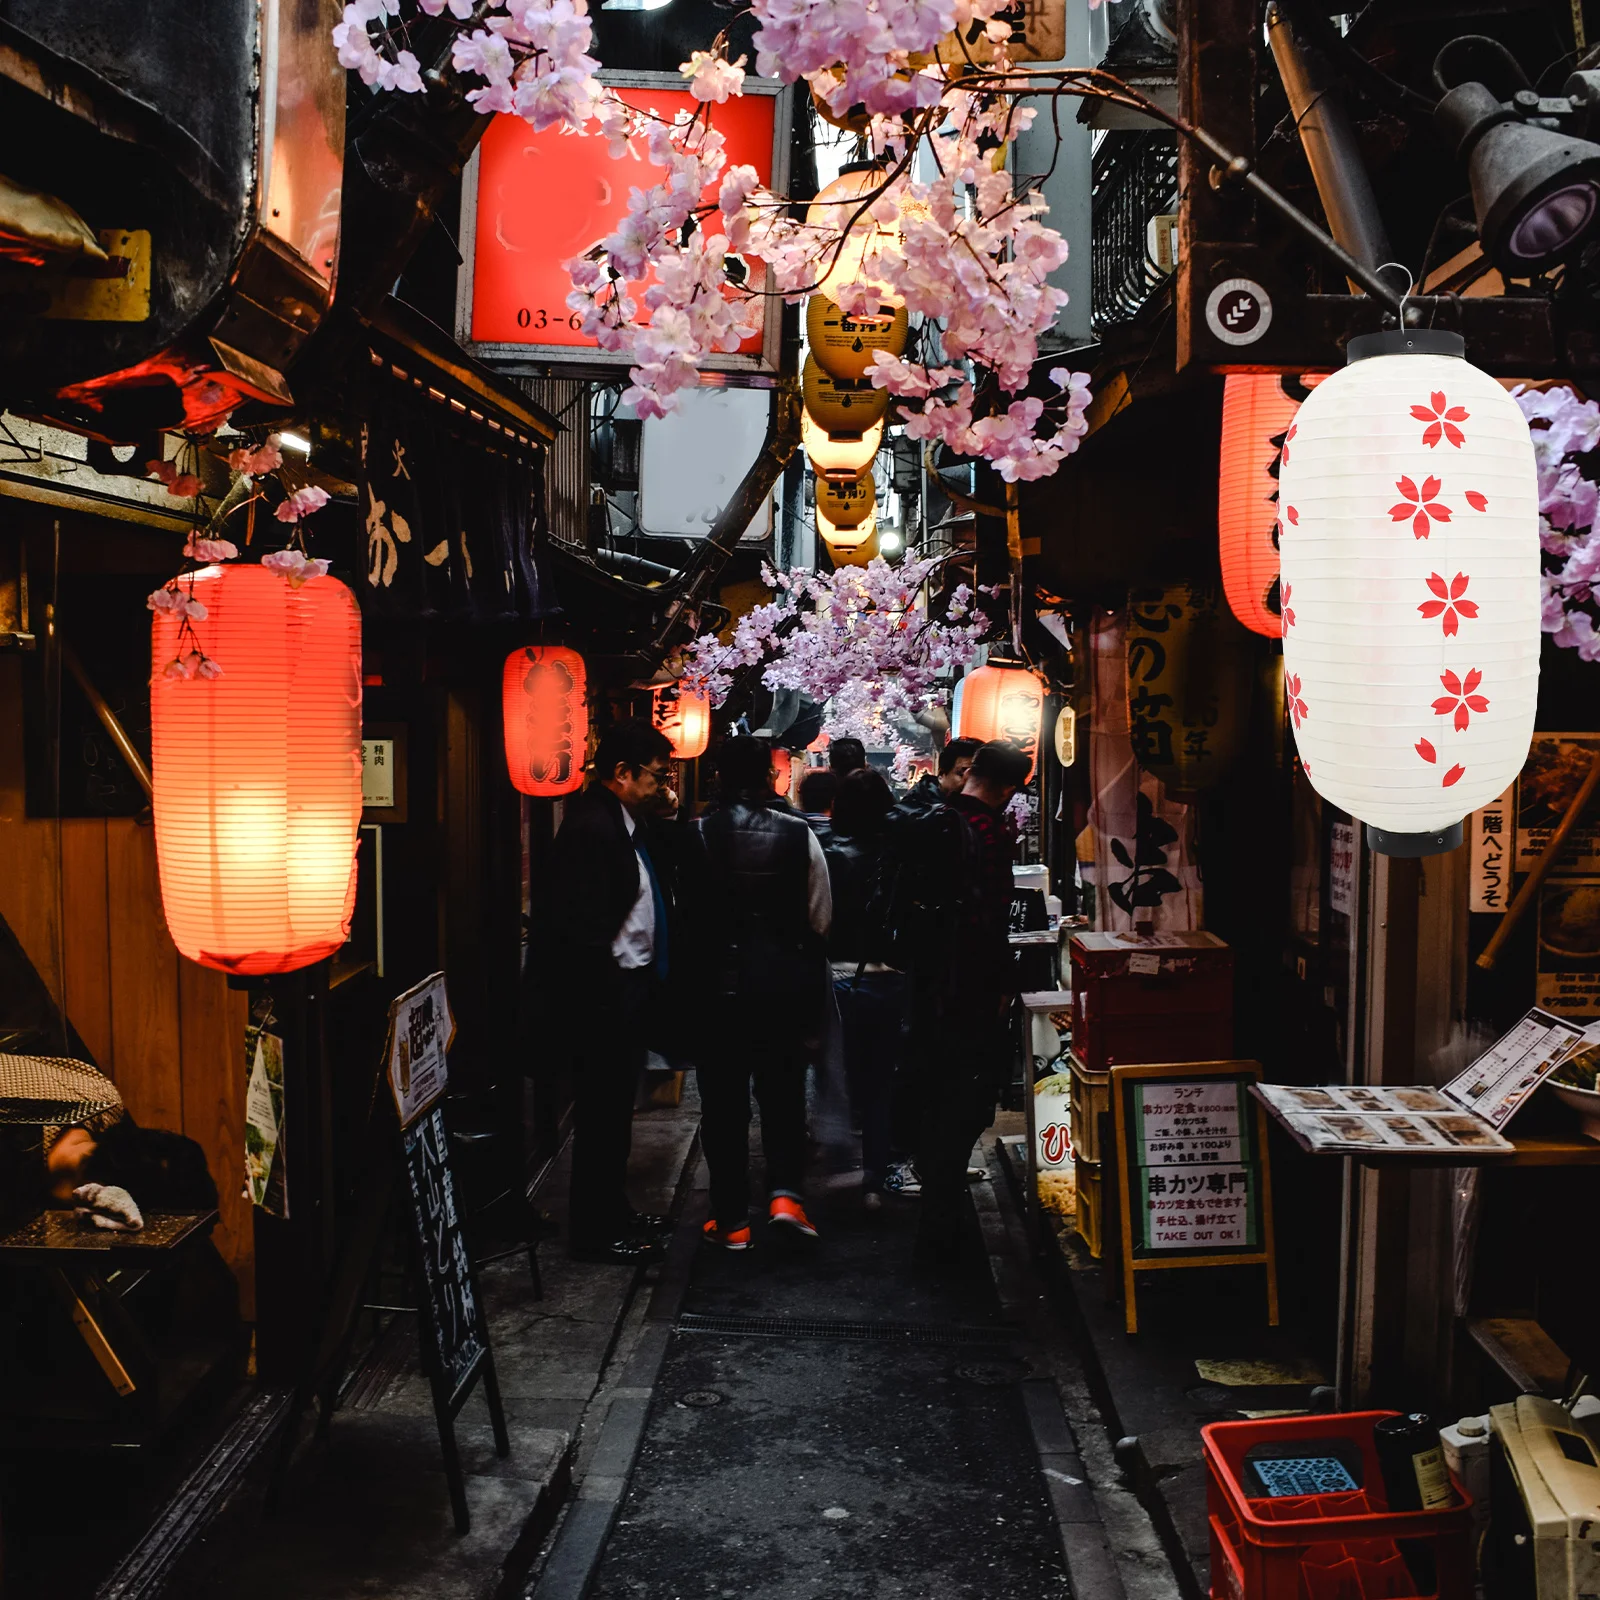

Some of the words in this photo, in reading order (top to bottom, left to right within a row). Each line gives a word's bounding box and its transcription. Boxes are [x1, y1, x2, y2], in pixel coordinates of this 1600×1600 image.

[374, 744, 385, 766] 精肉
[1173, 1087, 1204, 1099] ランチ
[1143, 1102, 1197, 1116] 串カツ定食
[1148, 1172, 1249, 1196] 串カツ専門
[1156, 1231, 1187, 1241] TAKE
[1193, 1230, 1214, 1240] OUT
